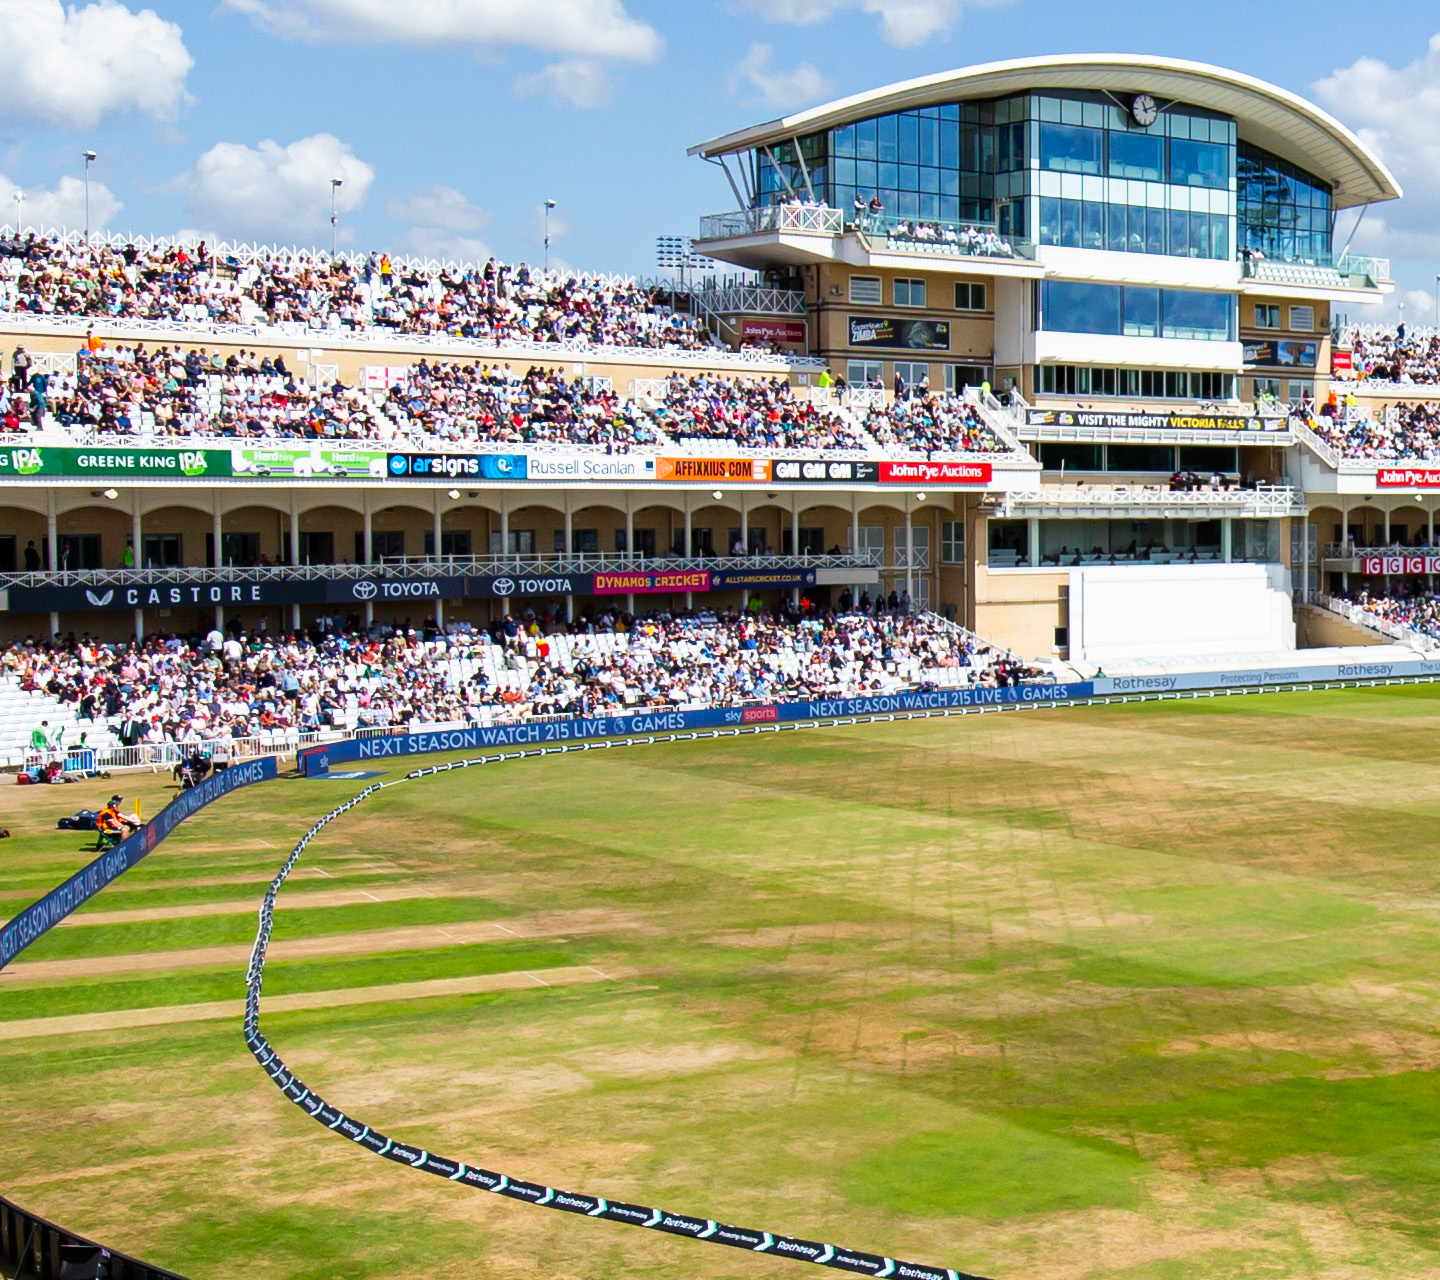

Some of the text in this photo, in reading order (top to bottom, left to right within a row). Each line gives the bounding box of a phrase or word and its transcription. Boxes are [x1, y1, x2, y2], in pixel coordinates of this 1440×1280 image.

[1078, 414, 1103, 426] VISIT
[1106, 415, 1126, 426] THE
[1128, 415, 1168, 428] MIGHTY
[1170, 417, 1216, 428] VICTORIA
[1217, 418, 1244, 428] FALLS
[11, 448, 44, 470] IPA
[77, 451, 208, 472] GREENE KING IPA
[413, 456, 479, 477] arsigns
[530, 459, 635, 474] Russell Scanlan
[675, 461, 752, 477] AFFIXXIUS.COM
[776, 462, 800, 478] GM
[802, 462, 826, 479] GM
[828, 463, 852, 479] GM
[889, 463, 917, 477] John
[918, 464, 938, 479] Pye
[940, 464, 983, 477] Auctions
[1380, 471, 1404, 483] John
[1405, 472, 1422, 486] Pye
[1366, 558, 1381, 573] IG
[1386, 558, 1400, 573] IG
[1406, 558, 1421, 573] IG
[382, 581, 440, 596] TOYOTA
[519, 578, 572, 593] TOYOTA
[596, 573, 708, 589] DYNAMOS CRICKET
[126, 585, 261, 605] CASTORE
[1220, 670, 1299, 685] Protecting Pensions
[809, 685, 1068, 718] NEXT SEASON WATCH 215 LIVE GAMES
[725, 708, 776, 723] sky sports
[359, 714, 685, 757] NEXT SEASON WATCH 215 LIVE GAMES
